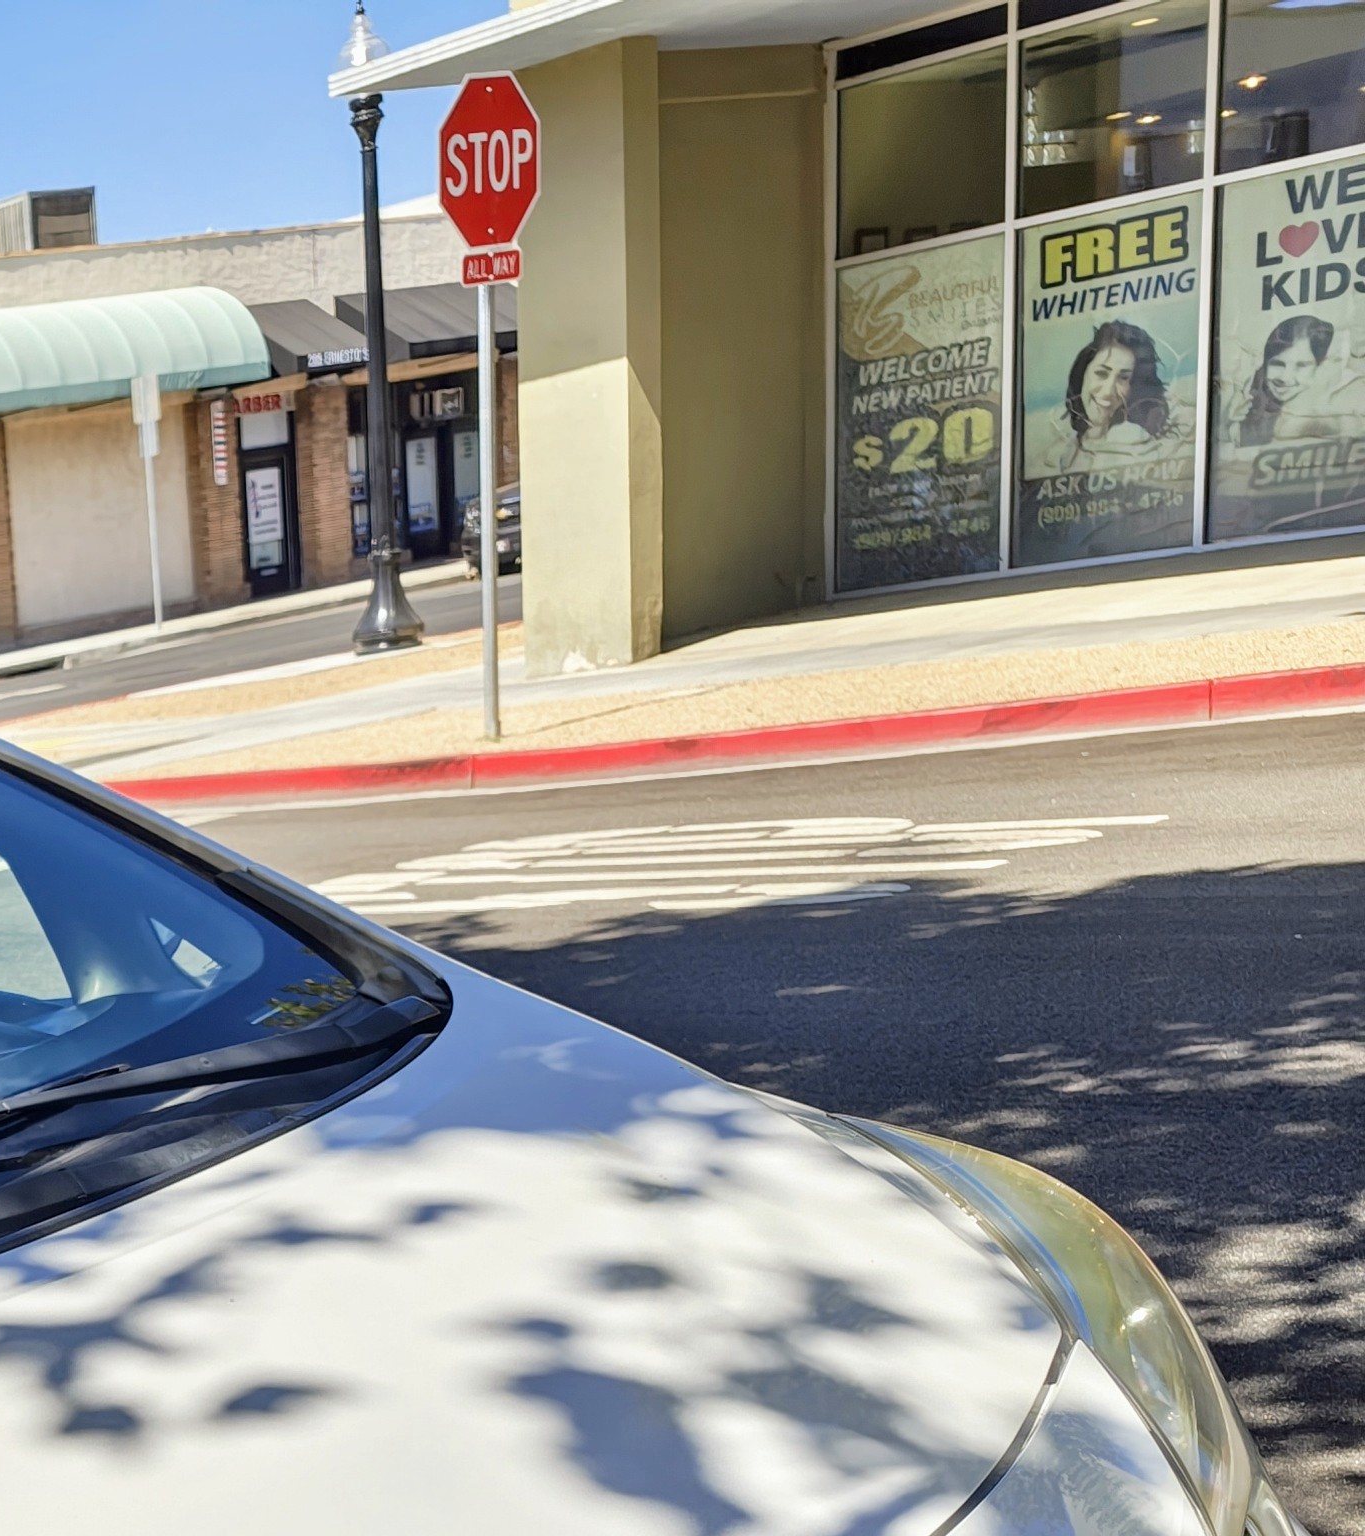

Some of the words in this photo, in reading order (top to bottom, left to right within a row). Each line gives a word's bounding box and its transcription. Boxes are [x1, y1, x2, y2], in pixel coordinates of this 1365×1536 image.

[445, 128, 533, 197] STOP
[1285, 164, 1365, 214] WE
[466, 258, 489, 280] ALL
[492, 254, 518, 277] WAY
[1042, 207, 1186, 287] FREE
[1032, 268, 1196, 322] WHITENING
[858, 337, 991, 386] WELCOME
[852, 386, 903, 415] NEW
[906, 369, 998, 406] PATIENT
[852, 407, 994, 474] $20
[1036, 474, 1084, 501] ASK
[1087, 469, 1118, 494] US
[1122, 459, 1187, 487] HOW
